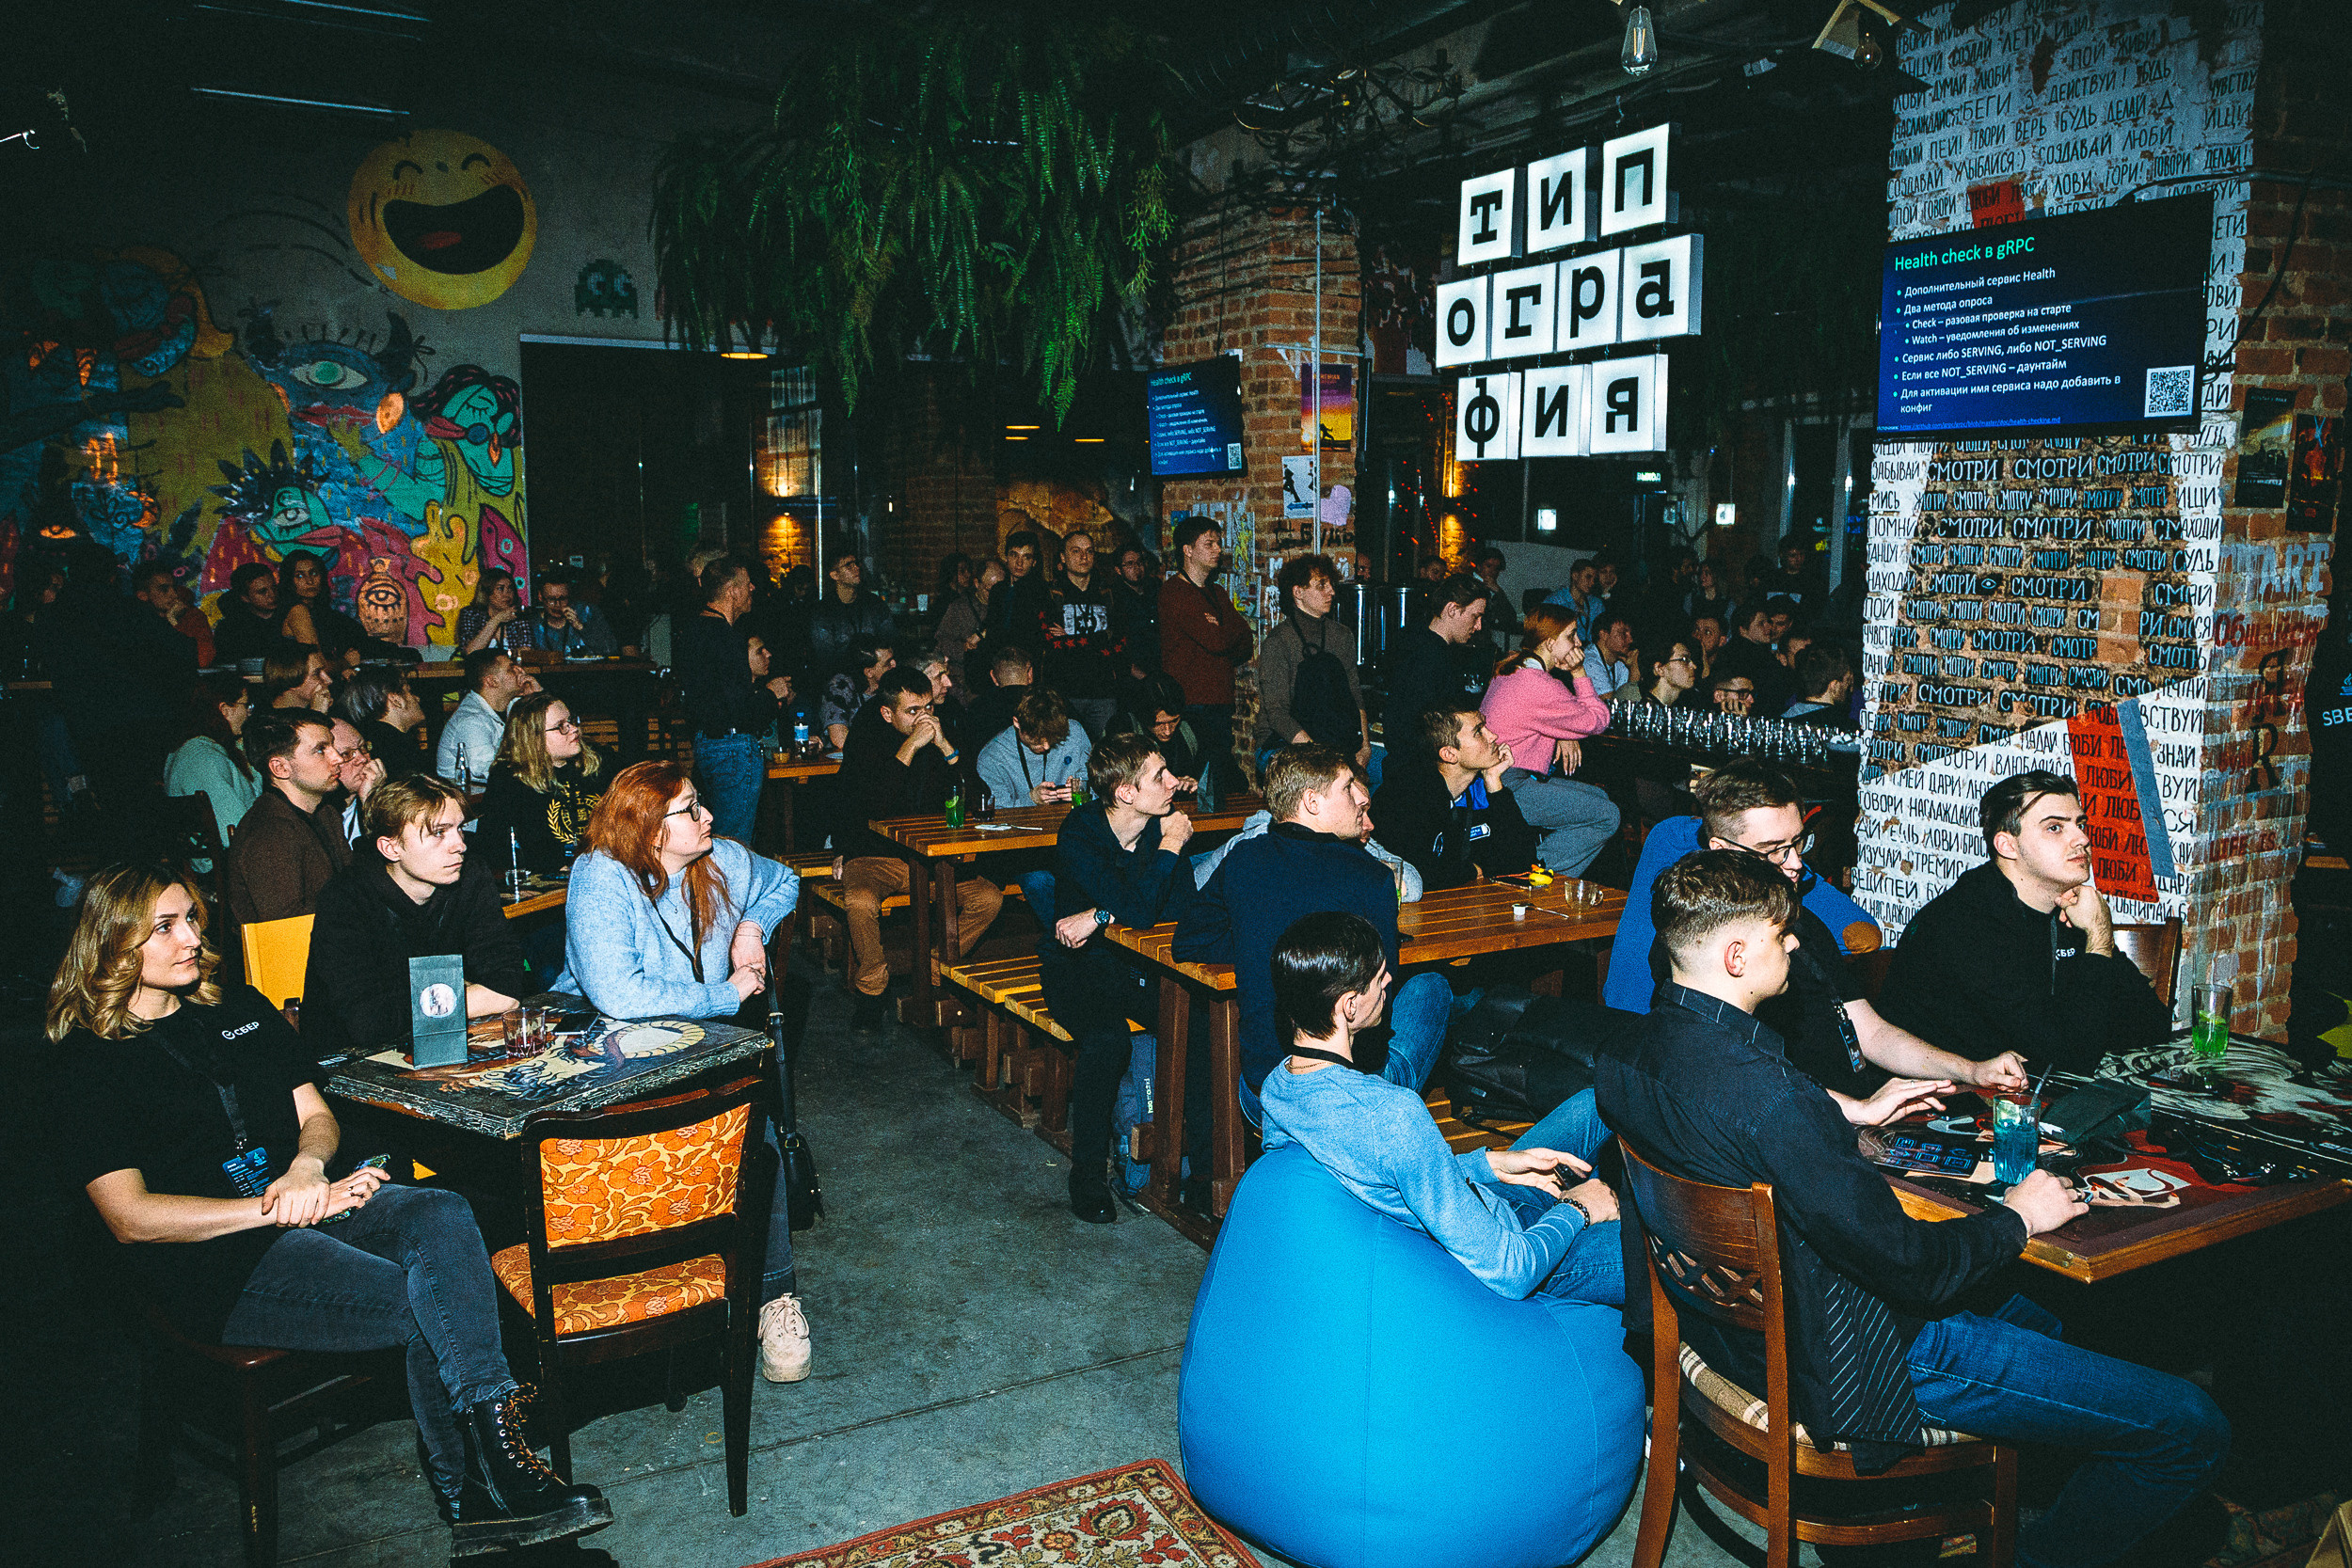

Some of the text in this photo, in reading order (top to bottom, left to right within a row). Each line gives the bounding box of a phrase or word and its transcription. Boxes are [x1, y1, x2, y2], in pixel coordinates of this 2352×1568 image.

[2001, 24, 2042, 55] ЛЕТИ
[1931, 74, 1968, 103] ДУМАЙ
[1977, 63, 2011, 91] ЛЮБИ
[2071, 40, 2106, 71] ПОЙ
[1963, 95, 2012, 122] БЕГИ
[2014, 118, 2047, 142] ВЕРЬ
[2059, 105, 2097, 133] БУДЬ
[2107, 92, 2147, 123] ДЕЛАЙ
[1887, 167, 1944, 200] СОЗДАВАЙ
[2039, 135, 2112, 167] СОЗДАВАЙ
[2122, 125, 2173, 151] ЛЮБИ
[1896, 202, 1917, 226] ПОЙ
[1923, 193, 1956, 220] ГОВОРИ
[1895, 237, 2035, 271] Health check в gRPC
[1904, 267, 2056, 298] Дополнительный сервис Health
[1903, 296, 1994, 316] Два метода опроса
[1912, 304, 2072, 329] Check разовая проверка на старте
[1912, 321, 2080, 345] Watch уведомления об изменениях
[1902, 335, 2107, 365] Сервис либо SERVING, либо NOT_SERVING
[1901, 358, 2067, 381] Если все NOT_SERVING даунтайм
[1900, 375, 2122, 401] Для активации имя сервиса надо добавить в
[1900, 403, 1933, 414] конфиг
[1872, 461, 1919, 481] ЗАБЫВАЙ
[1928, 460, 1999, 482] СМОТРИ
[2014, 457, 2093, 481] СМОТРИ
[2097, 451, 2155, 475] СМОТРИ
[1871, 491, 1900, 510] МИСЬ
[1953, 489, 1991, 511] СМОТРИ
[1995, 489, 2033, 511] СМОТРИ
[2178, 486, 2216, 514] ИЩИ
[1867, 517, 1916, 537] ПОМНИ
[1937, 517, 2005, 538] СМОТРИ
[2013, 517, 2093, 540] СМОТРИ
[2106, 519, 2146, 541] СМОТРИ
[1910, 545, 1946, 564] СМОТРИ
[1948, 544, 1984, 564] СМОТРИ
[1989, 546, 2024, 566] СМОТРИ
[2031, 550, 2068, 570] СМОТРИ
[2124, 548, 2166, 570] СМОТРИ
[1929, 573, 2086, 601] СМОТРИ СМОТРИ
[1864, 597, 1895, 619] ПОЙ
[1906, 599, 1942, 621] СМОТРИ
[1947, 599, 1983, 621] СМОТРИ
[1988, 601, 2026, 626] СМОТРИ
[2031, 606, 2066, 628] СМОТРИ
[1930, 627, 1965, 650] СМОТРИ
[1972, 630, 2036, 654] СМОТРИ
[1903, 654, 1938, 676] СМОТРИ
[1982, 660, 2018, 683] СМОТРИ
[2026, 664, 2063, 685] СМОТРИ
[2069, 665, 2109, 688] СМОТРИ
[1918, 683, 1991, 705] СМОТРИ
[2085, 765, 2133, 790] ЛЮБИ
[2162, 773, 2198, 803] ВУЙ
[1859, 790, 1902, 815] ГОВОРИ
[1929, 772, 1962, 798] ДАРИ
[2164, 809, 2194, 834] СЯ
[1858, 844, 1902, 867] ИЗУЧАЙ
[2096, 858, 2137, 882] ЛЮБИ
[1884, 877, 1918, 899] ПЕЙ
[234, 1022, 260, 1036] СБЕР
